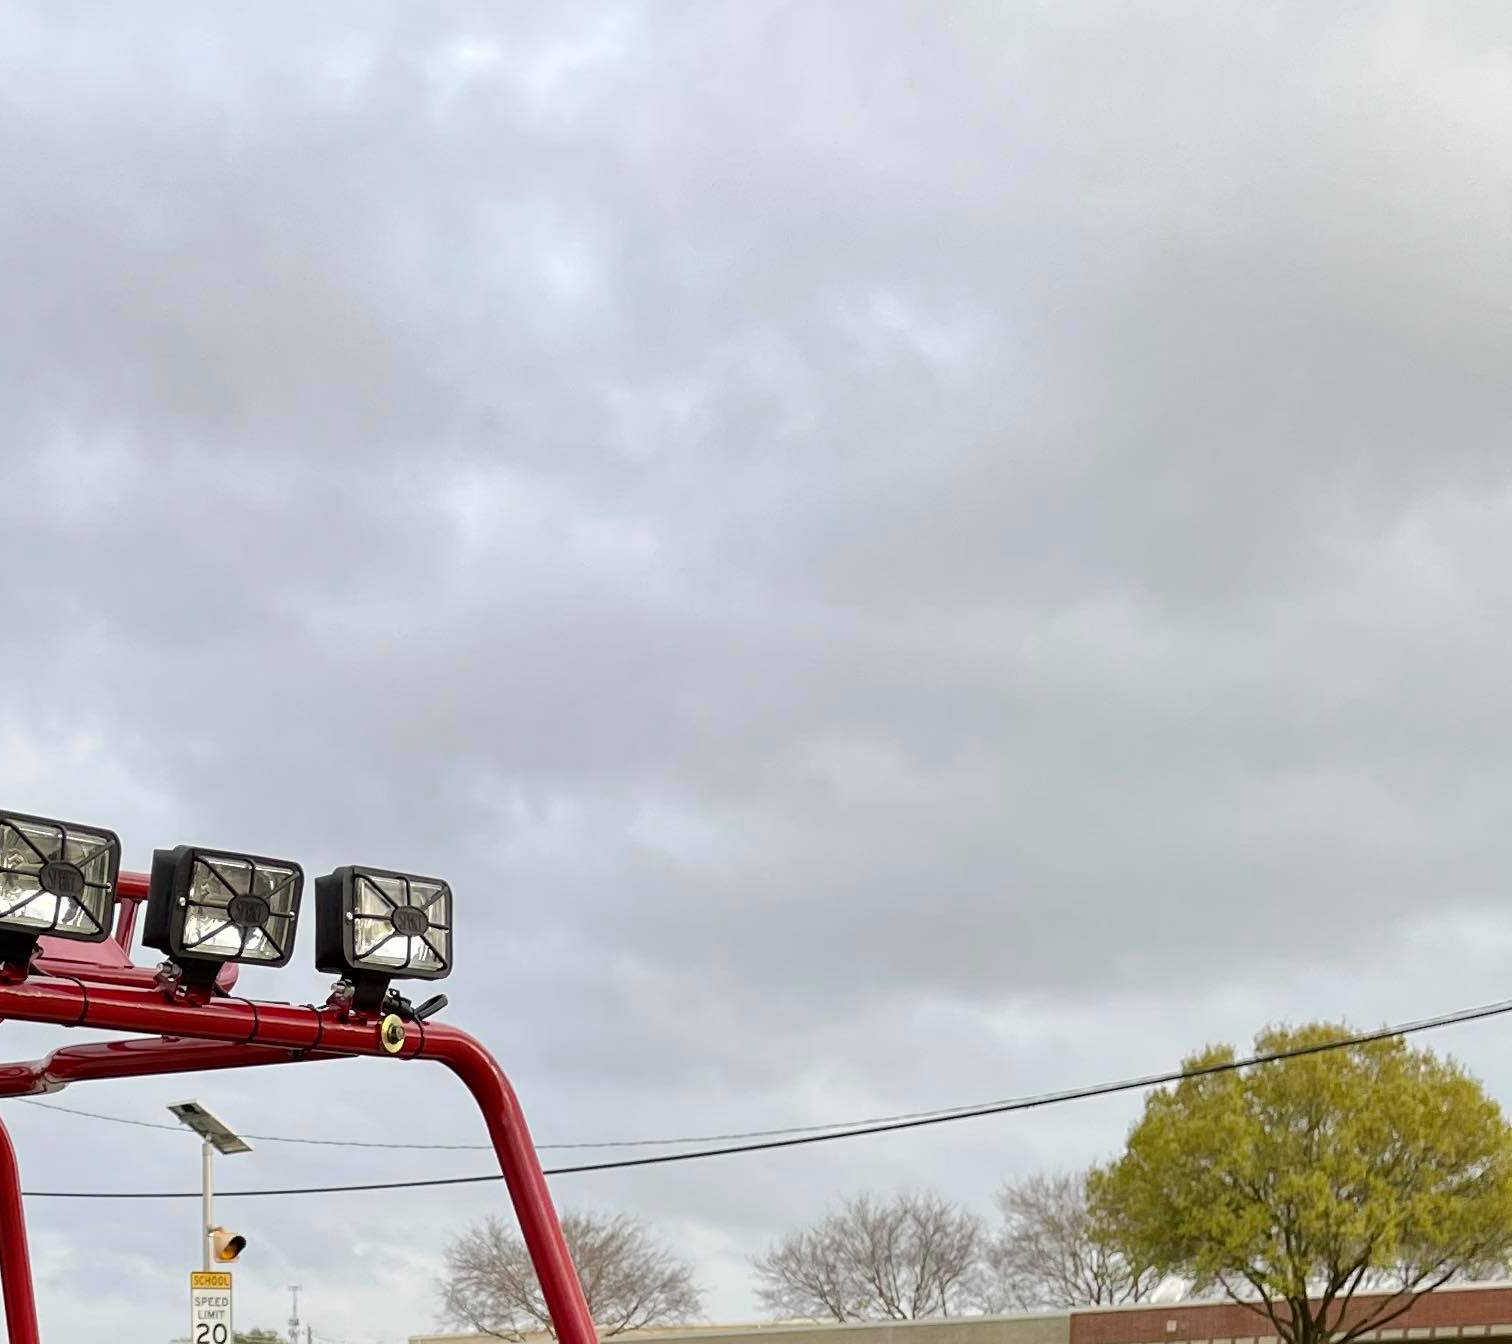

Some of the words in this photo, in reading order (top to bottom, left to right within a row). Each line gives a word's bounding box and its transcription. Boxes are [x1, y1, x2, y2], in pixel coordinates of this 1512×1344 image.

[193, 1275, 229, 1286] SCHOOL
[194, 1296, 229, 1307] SPEED
[197, 1310, 225, 1320] LIMIT
[196, 1323, 228, 1344] 20
